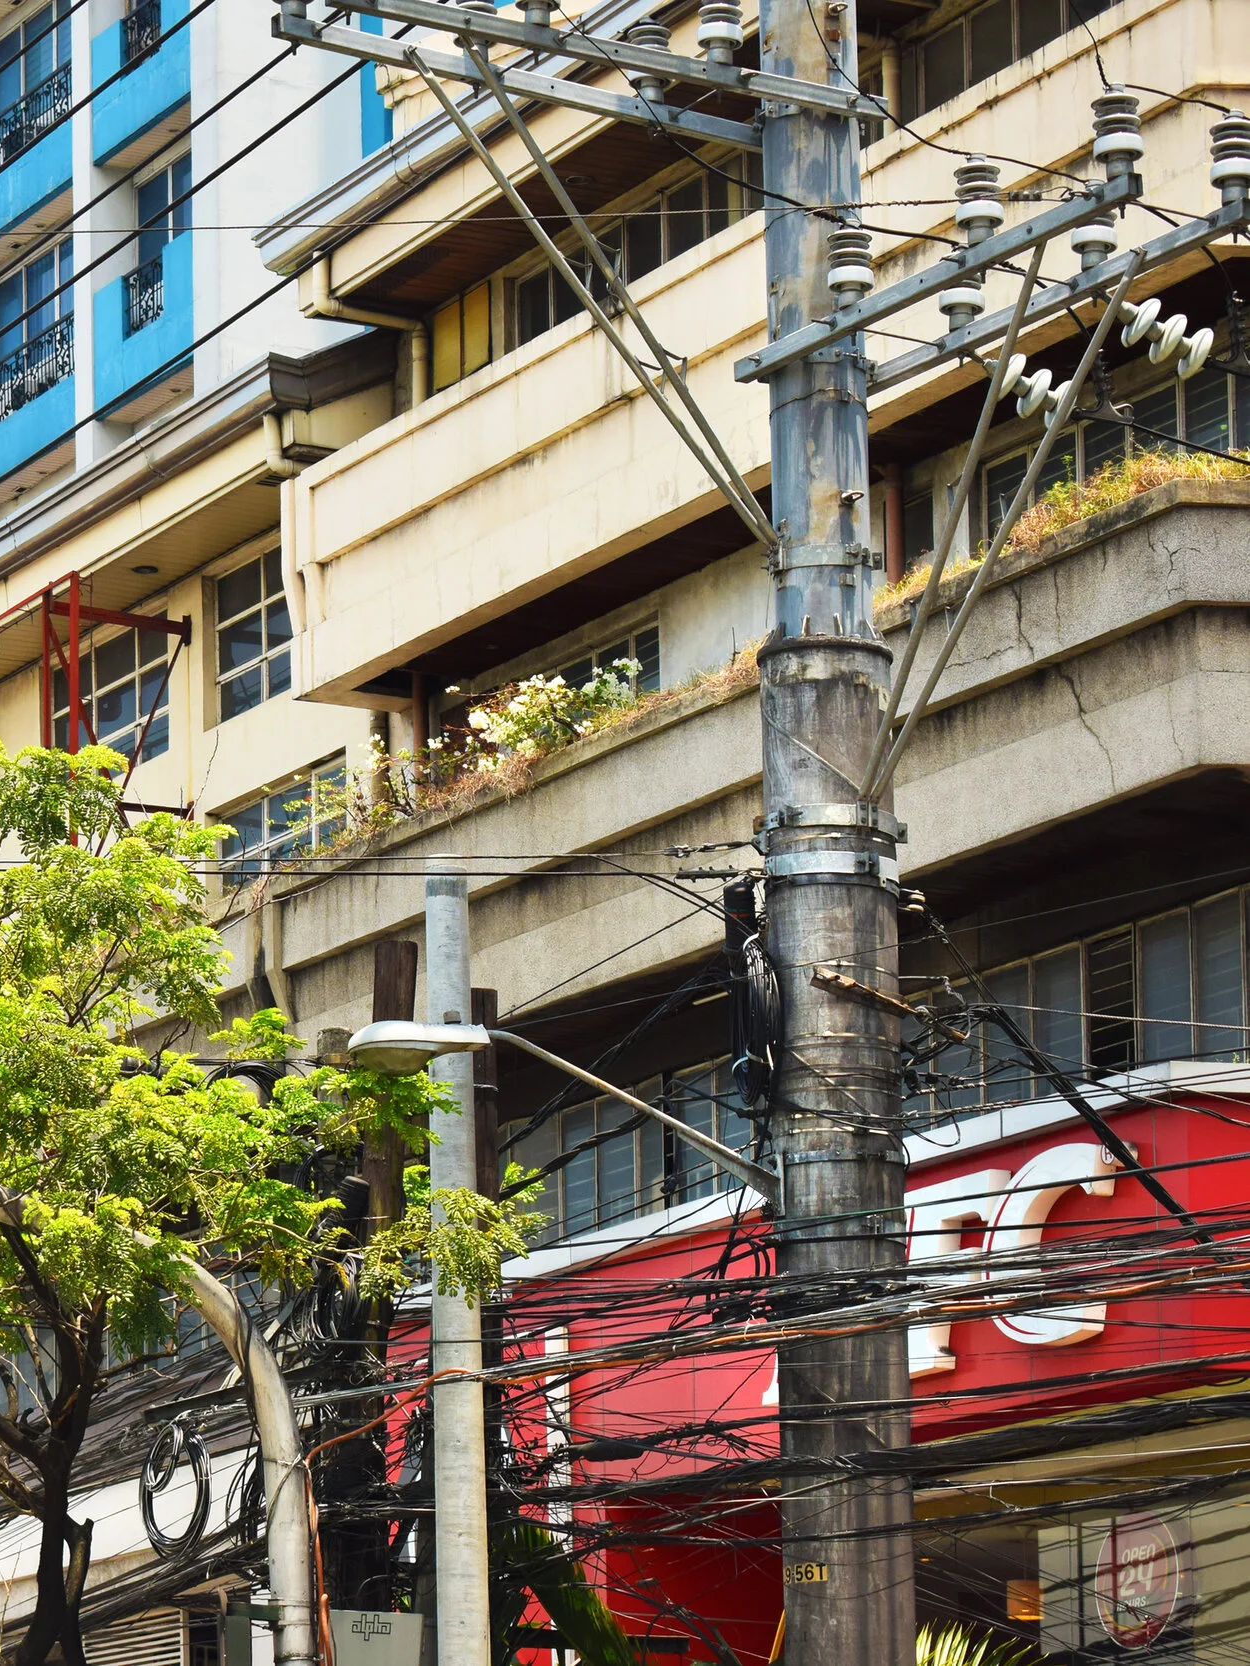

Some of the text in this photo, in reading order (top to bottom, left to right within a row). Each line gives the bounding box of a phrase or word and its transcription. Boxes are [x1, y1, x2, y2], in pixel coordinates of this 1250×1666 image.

[762, 1142, 1138, 1405] FC
[1121, 1543, 1156, 1565] OPEN
[1119, 1561, 1154, 1596] 24
[351, 1613, 392, 1641] alpha
